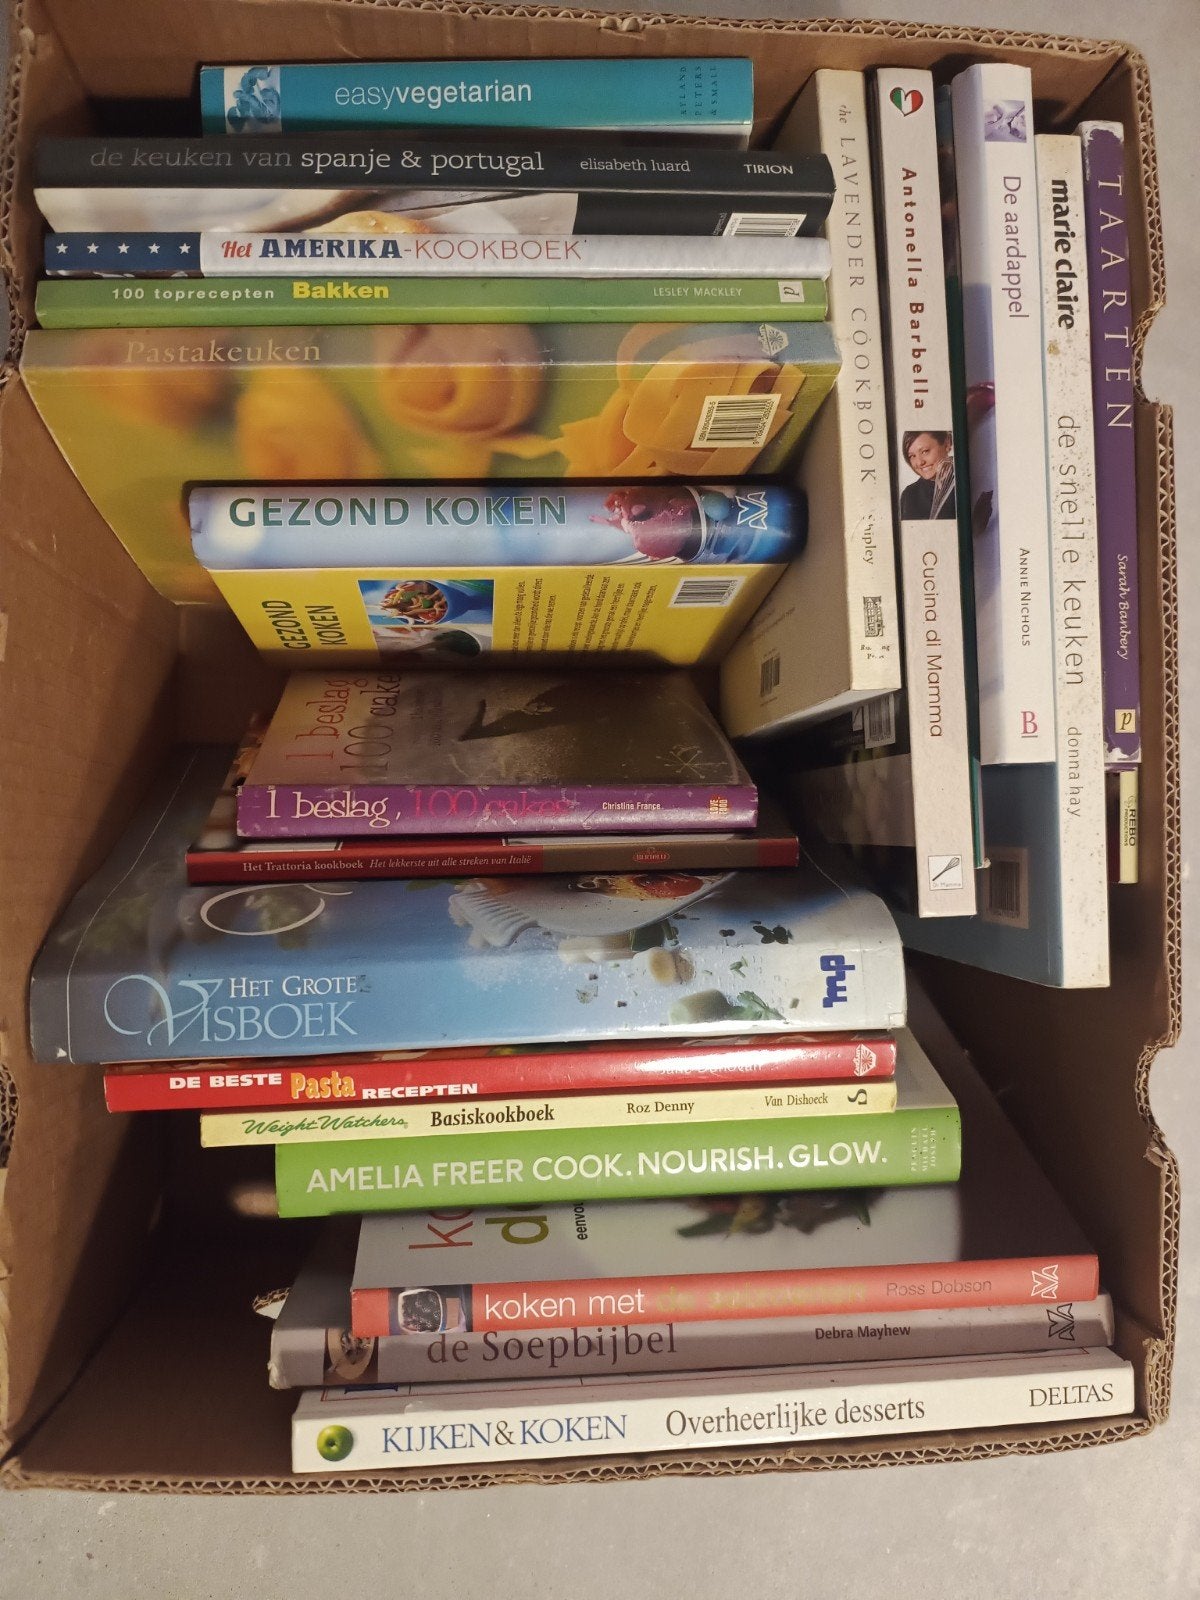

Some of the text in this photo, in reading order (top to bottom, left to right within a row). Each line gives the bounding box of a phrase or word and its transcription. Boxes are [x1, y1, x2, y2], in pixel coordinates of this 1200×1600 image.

[335, 79, 533, 110] easyvegetarian
[90, 146, 545, 177] de keuken van spanje & portugal
[579, 157, 691, 173] elisabeth luard
[743, 163, 794, 175] TIRION
[840, 137, 865, 288] LAVENDER
[221, 239, 253, 259] Het
[1001, 175, 1030, 318] De aardappel
[1050, 179, 1079, 330] marie claire
[111, 281, 390, 302] 100 toprecepten Bakken
[653, 286, 743, 297] LESLEY MACKLEY
[900, 167, 929, 409] Antonella Barbella
[1098, 174, 1133, 429] TAARTEN
[125, 338, 322, 365] Pastakeuken
[851, 307, 877, 482] COOKBOOK
[229, 495, 568, 527] GEZOND KOKEN
[1057, 415, 1089, 686] de snelle keuken
[1117, 553, 1129, 598] Sarah
[1019, 548, 1031, 647] ANNIE NICHOLS
[261, 600, 312, 650] GEZOND
[304, 605, 348, 646] KOKEN
[922, 551, 943, 738] Cucina di Mamma
[360, 672, 402, 717] cake
[1021, 710, 1039, 736] B
[1067, 726, 1084, 817] donna hay
[265, 789, 281, 818] 1
[414, 789, 479, 818] 100
[602, 801, 662, 812] Christine France
[1128, 808, 1137, 847] REBO
[243, 854, 532, 872] Het Trattoria kookboek Het lekkerste uit alle streken van Italië
[169, 1070, 478, 1100] DE BESTE Pasta RECEPTEN
[764, 1092, 829, 1108] Van Dishoeck
[431, 1104, 555, 1128] Basiskookboek
[626, 1099, 695, 1115] Roz Denny
[242, 1117, 318, 1137] Weight
[306, 1140, 888, 1194] AMELIA FREER COOK. NOURISH. GLOW.
[886, 1279, 992, 1297] Ross Dobson
[485, 1293, 576, 1320] koken
[588, 1288, 645, 1315] met
[427, 1323, 678, 1369] de Soepbijbel
[815, 1324, 911, 1341] Debra Mayhew
[1028, 1383, 1114, 1408] DELTAS
[665, 1397, 926, 1437] Overheerlijke desserts
